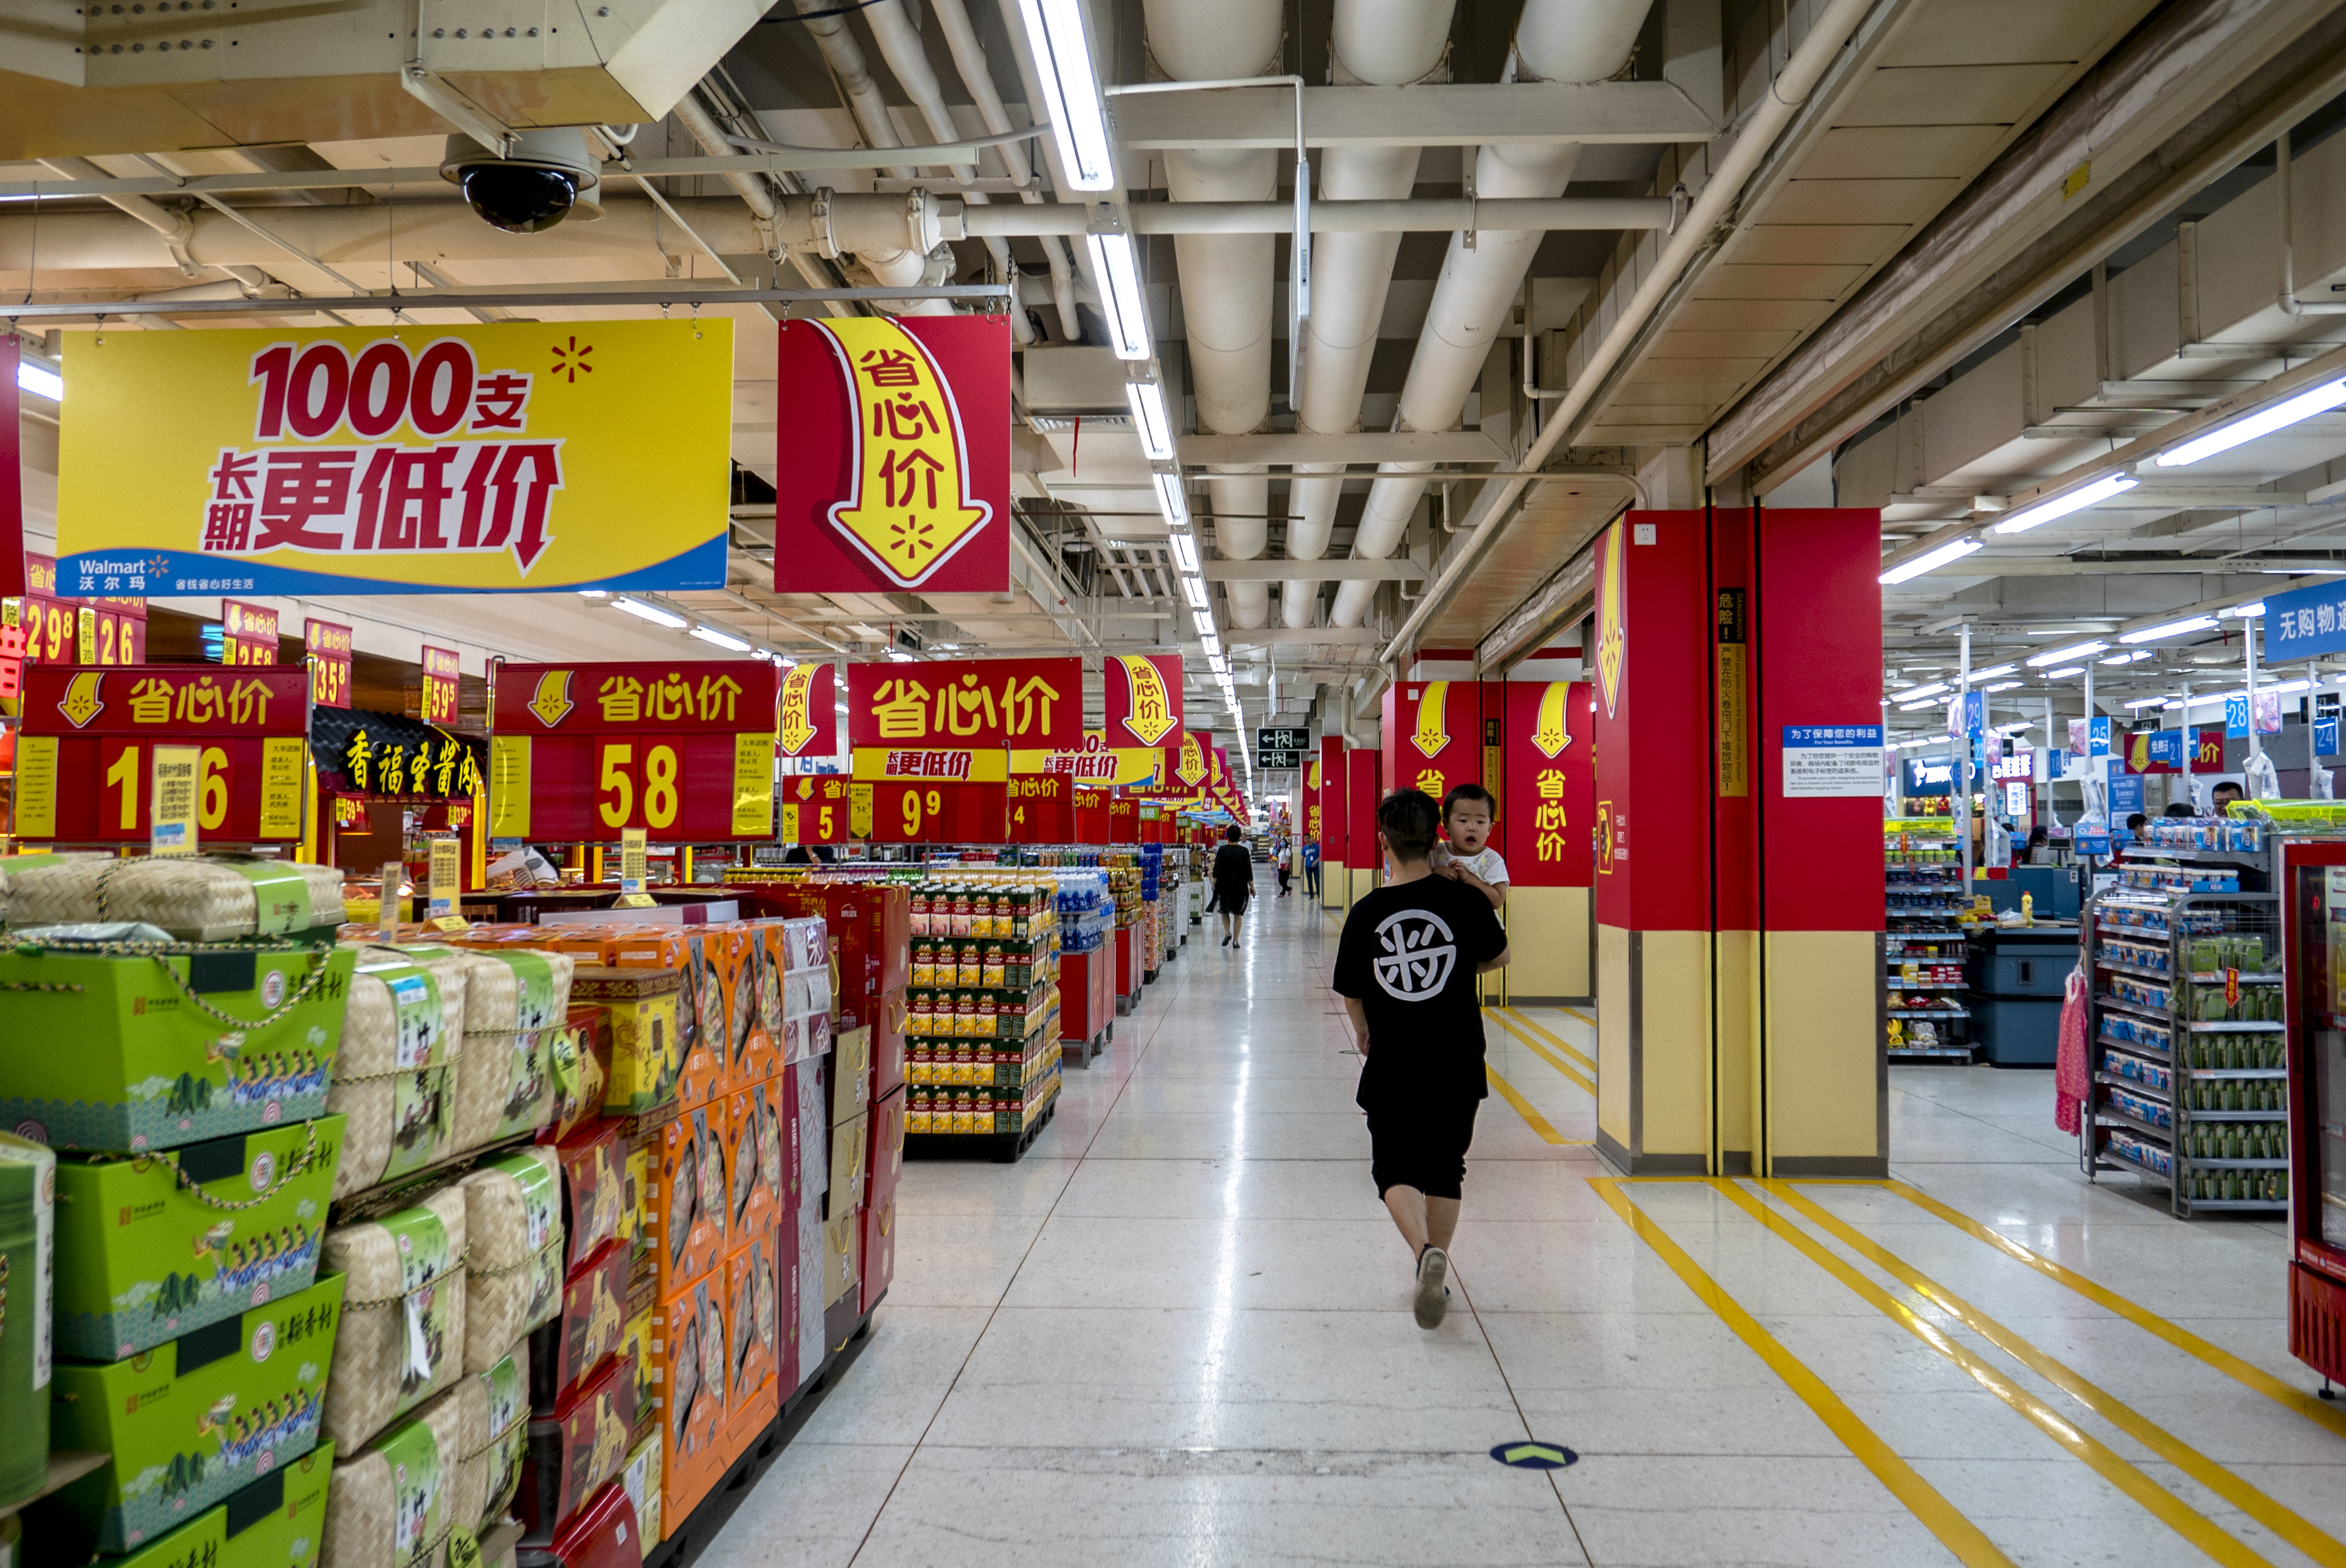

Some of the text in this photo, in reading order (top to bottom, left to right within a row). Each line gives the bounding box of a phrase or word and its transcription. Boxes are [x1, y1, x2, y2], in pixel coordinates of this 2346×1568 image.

[252, 338, 530, 438] 1000支
[860, 349, 945, 509] 省心价
[203, 442, 561, 571] 长期更低价
[79, 560, 146, 575] Walmart
[79, 576, 146, 591] 沃尔玛
[175, 579, 255, 591] 省钱省心好生活
[244, 612, 276, 637] 省心价
[323, 630, 350, 652] 省心价
[128, 677, 274, 725] 省心价
[598, 672, 743, 722] 省心价
[783, 673, 808, 730] 省心价
[871, 674, 1060, 738] 省心价
[1132, 666, 1162, 720] 省心价
[1967, 702, 1981, 728] 29
[2228, 704, 2247, 728] 28
[1791, 729, 1877, 739] 为了保障您的利益
[2318, 728, 2334, 747] 24
[885, 750, 973, 782] 长期更低价
[2052, 756, 2060, 772] 18
[2169, 743, 2181, 760] 21
[599, 744, 678, 829] 58
[819, 806, 833, 840] 5
[1536, 769, 1567, 862] 省心价
